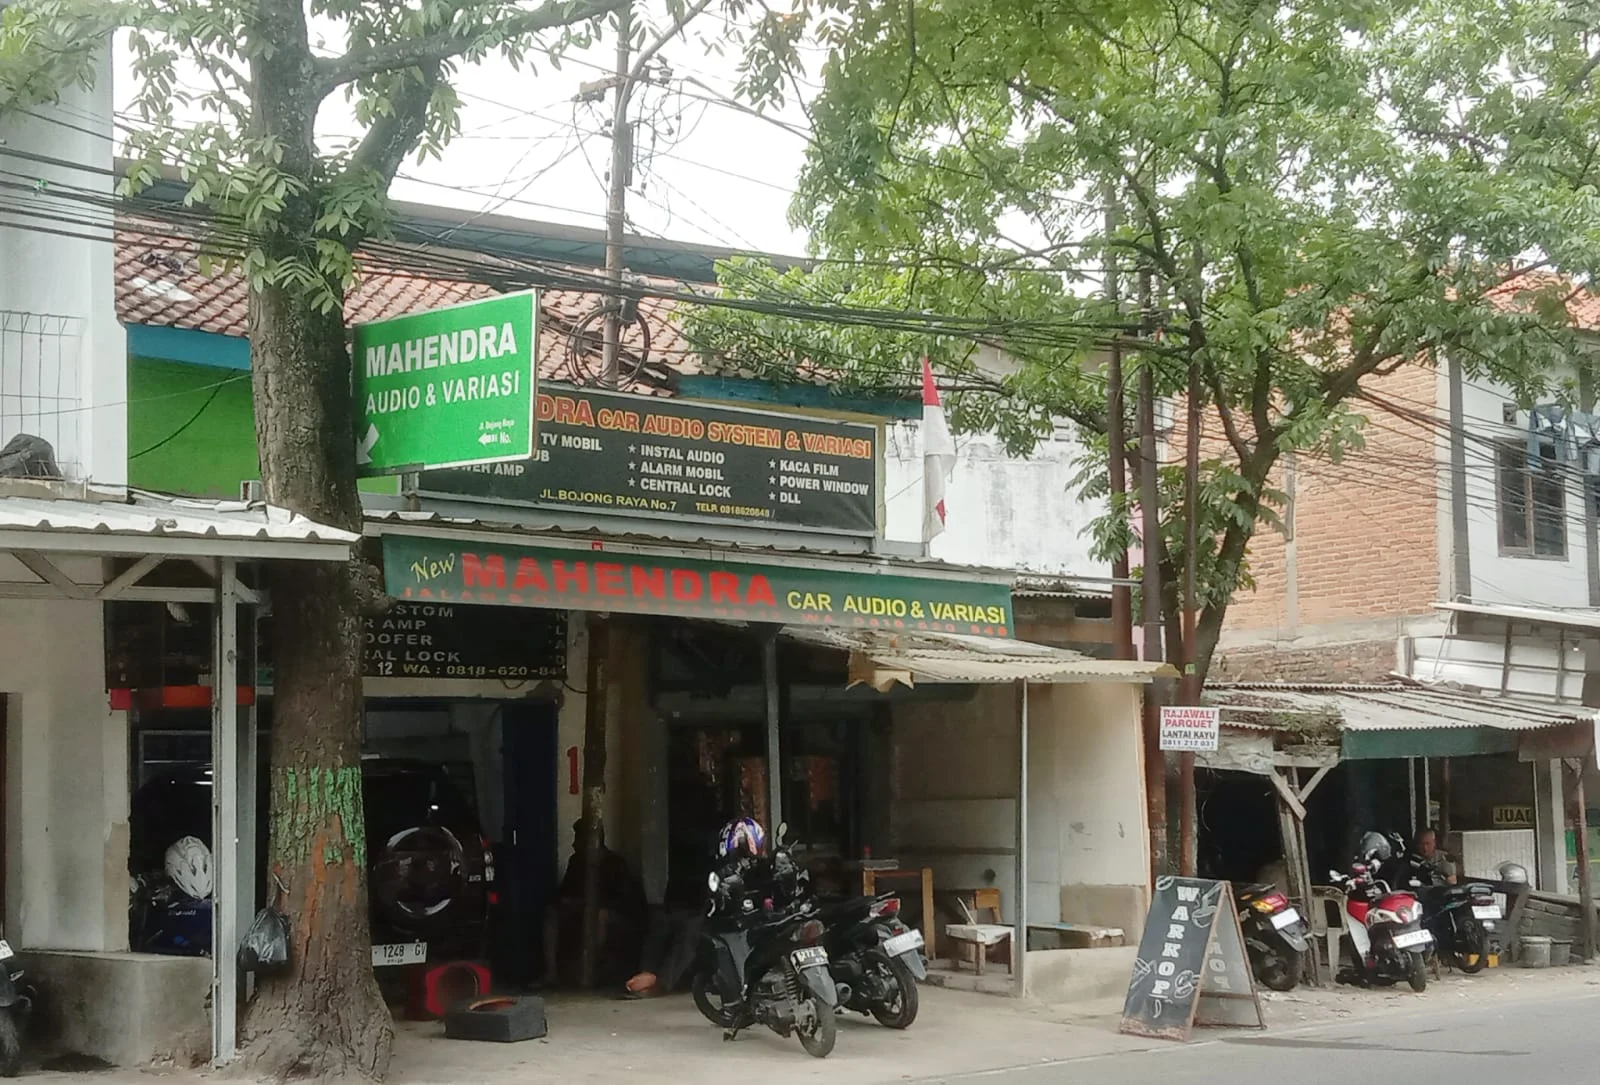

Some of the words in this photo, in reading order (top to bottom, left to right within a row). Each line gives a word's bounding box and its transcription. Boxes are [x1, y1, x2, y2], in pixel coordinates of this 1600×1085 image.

[366, 322, 517, 378] MAHENDRA
[365, 386, 420, 416] AUDIO
[425, 383, 436, 406] &
[442, 370, 520, 404] VARIASI
[541, 432, 558, 446] TV
[561, 434, 602, 451] MOBIL
[597, 408, 640, 432] CAR
[642, 414, 704, 440] AUDIO
[707, 422, 781, 448] SYSTEM
[785, 431, 800, 450] &
[802, 432, 872, 459] VARIASI
[640, 444, 684, 460] INSTAL
[686, 450, 725, 465] AUDIO
[494, 463, 525, 477] AMP
[640, 460, 682, 477] ALARM
[685, 465, 724, 481] MOBIL
[780, 459, 810, 474] KACA
[813, 463, 839, 476] FILM
[640, 479, 696, 494] CENTRAL
[699, 483, 732, 498] LOCK
[780, 475, 821, 491] POWER
[823, 480, 869, 496] WINDOW
[616, 495, 649, 509] RAYA
[651, 499, 677, 511] No.7
[780, 491, 801, 504] DLL
[411, 552, 456, 583] New
[461, 552, 777, 607] MAHENDRA
[787, 591, 832, 612] CAR
[843, 595, 907, 618] AUDIO
[911, 601, 925, 618] &
[929, 602, 1006, 624] VARIASI
[382, 619, 427, 631] AMP
[405, 650, 461, 663] LOCK
[377, 662, 393, 675] 12
[403, 664, 430, 675] WA
[1163, 709, 1216, 719] RAJAWALI
[1165, 719, 1214, 728] PARQUET
[1162, 730, 1191, 739] LANTAI
[1193, 731, 1216, 740] KAYU
[383, 945, 405, 958] 1248
